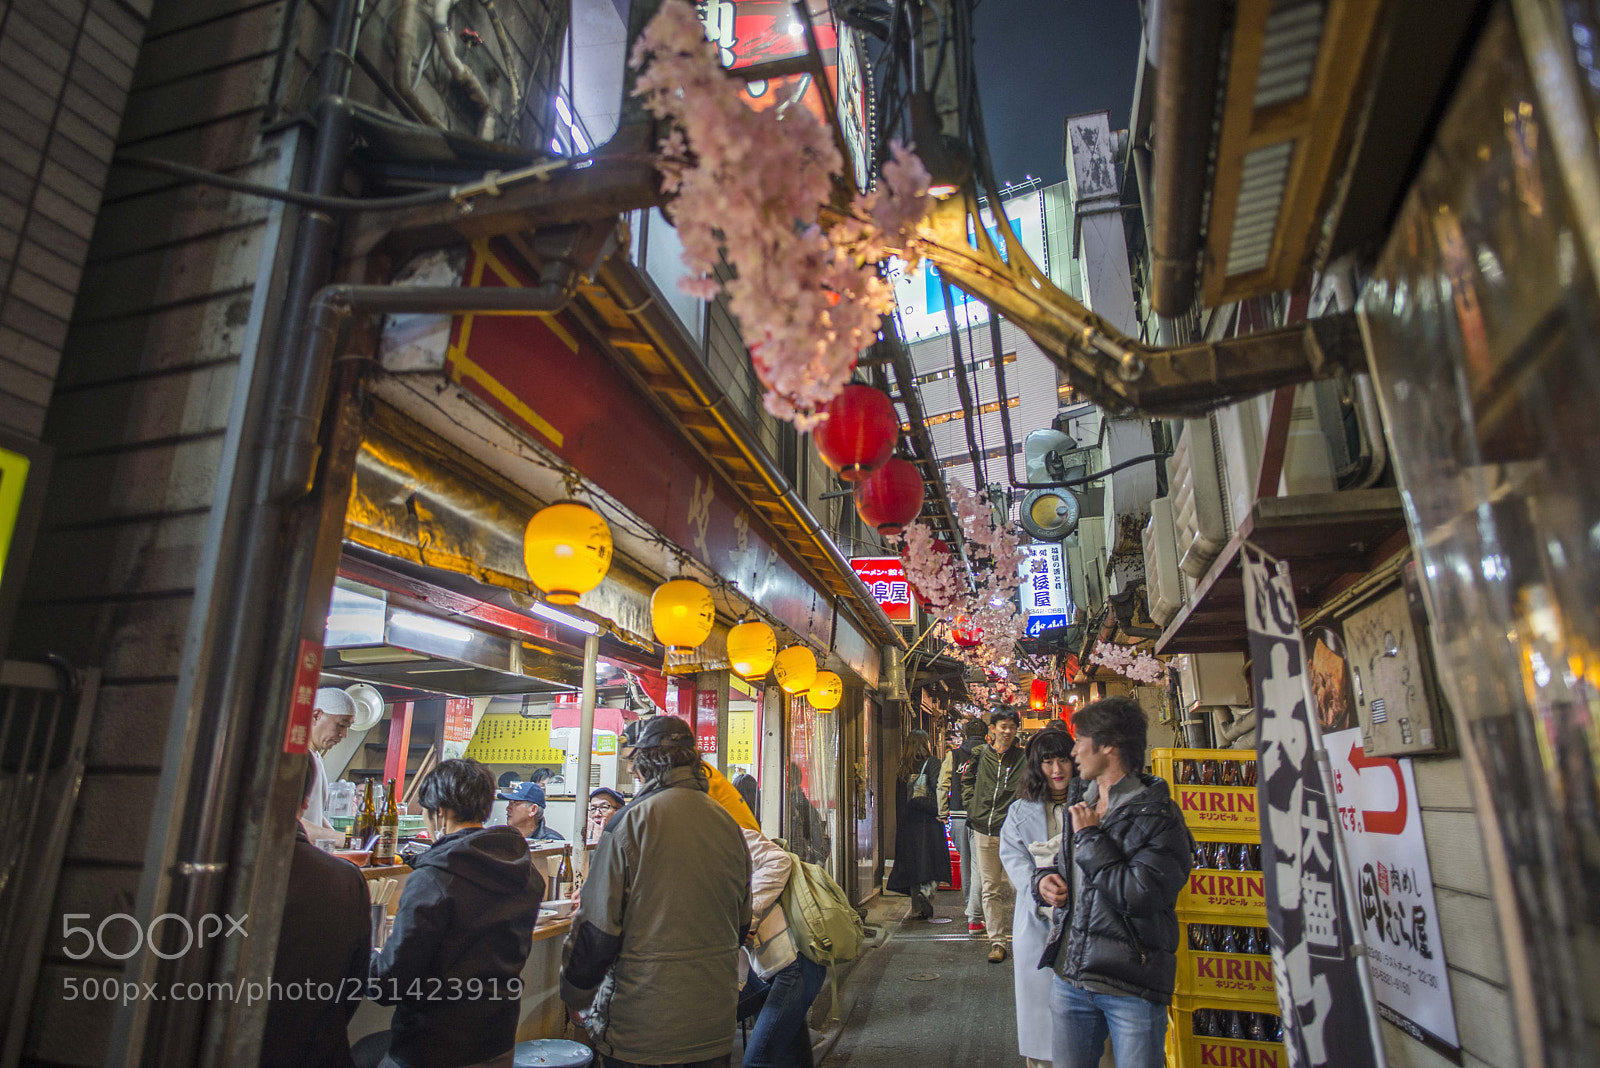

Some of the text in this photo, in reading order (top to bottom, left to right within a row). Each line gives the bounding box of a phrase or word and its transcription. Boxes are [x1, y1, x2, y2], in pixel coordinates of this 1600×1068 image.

[863, 581, 909, 604] 阜屋
[1181, 791, 1255, 813] KIRIN
[1199, 812, 1239, 822] キリンビール
[1300, 800, 1339, 948] 大盛
[1190, 874, 1265, 898] KIRIN
[1207, 896, 1248, 906] キリンビール
[1197, 956, 1273, 983] KIRIN
[1215, 980, 1256, 991] キリンビール
[1200, 1043, 1278, 1068] KIRIN
